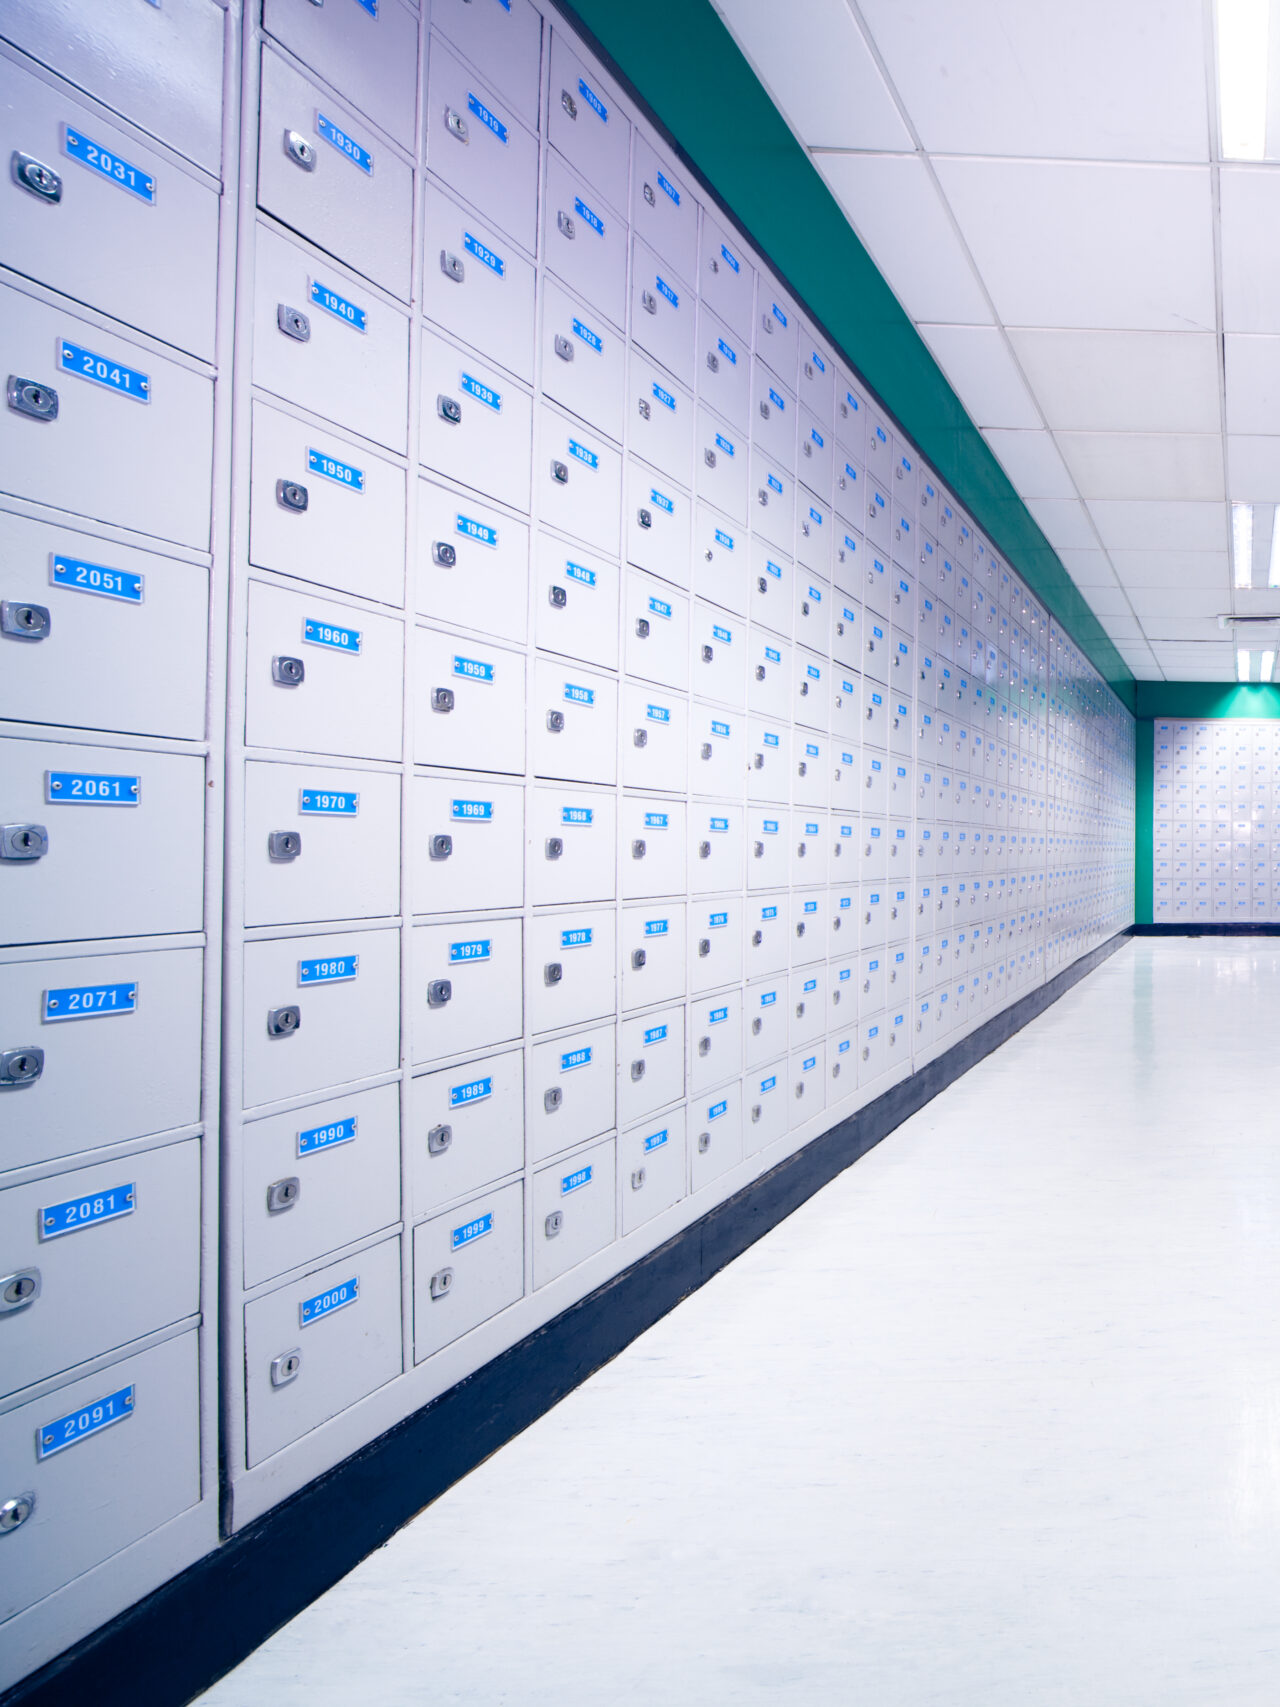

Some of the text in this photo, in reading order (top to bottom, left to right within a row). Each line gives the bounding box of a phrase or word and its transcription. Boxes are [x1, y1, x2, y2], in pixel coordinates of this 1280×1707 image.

[479, 105, 498, 134] 1919
[330, 125, 360, 162] 1930
[87, 144, 135, 187] 2031
[583, 205, 597, 229] 1918
[474, 241, 495, 268] 1929
[324, 291, 354, 321] 1940
[580, 325, 596, 347] 1928
[83, 355, 129, 389] 2041
[471, 380, 493, 404] 1939
[575, 445, 592, 465] 1938
[322, 458, 352, 483] 1950
[466, 521, 489, 541] 1949
[76, 566, 121, 591] 2051
[573, 566, 590, 582] 1948
[318, 626, 348, 646] 1960
[463, 661, 485, 677] 1959
[572, 687, 588, 701] 1958
[72, 779, 119, 797] 2061
[316, 795, 345, 809] 1970
[462, 803, 484, 816] 1969
[570, 810, 586, 821] 1968
[569, 931, 586, 943] 1978
[461, 944, 482, 957] 1979
[315, 961, 345, 977] 1980
[69, 990, 116, 1010] 2071
[569, 1051, 585, 1065] 1988
[462, 1082, 484, 1099] 1989
[313, 1124, 344, 1146] 1990
[569, 1170, 586, 1188] 1998
[66, 1194, 114, 1224] 2081
[463, 1219, 484, 1240] 1999
[314, 1286, 347, 1314] 2000
[65, 1400, 113, 1439] 2091
